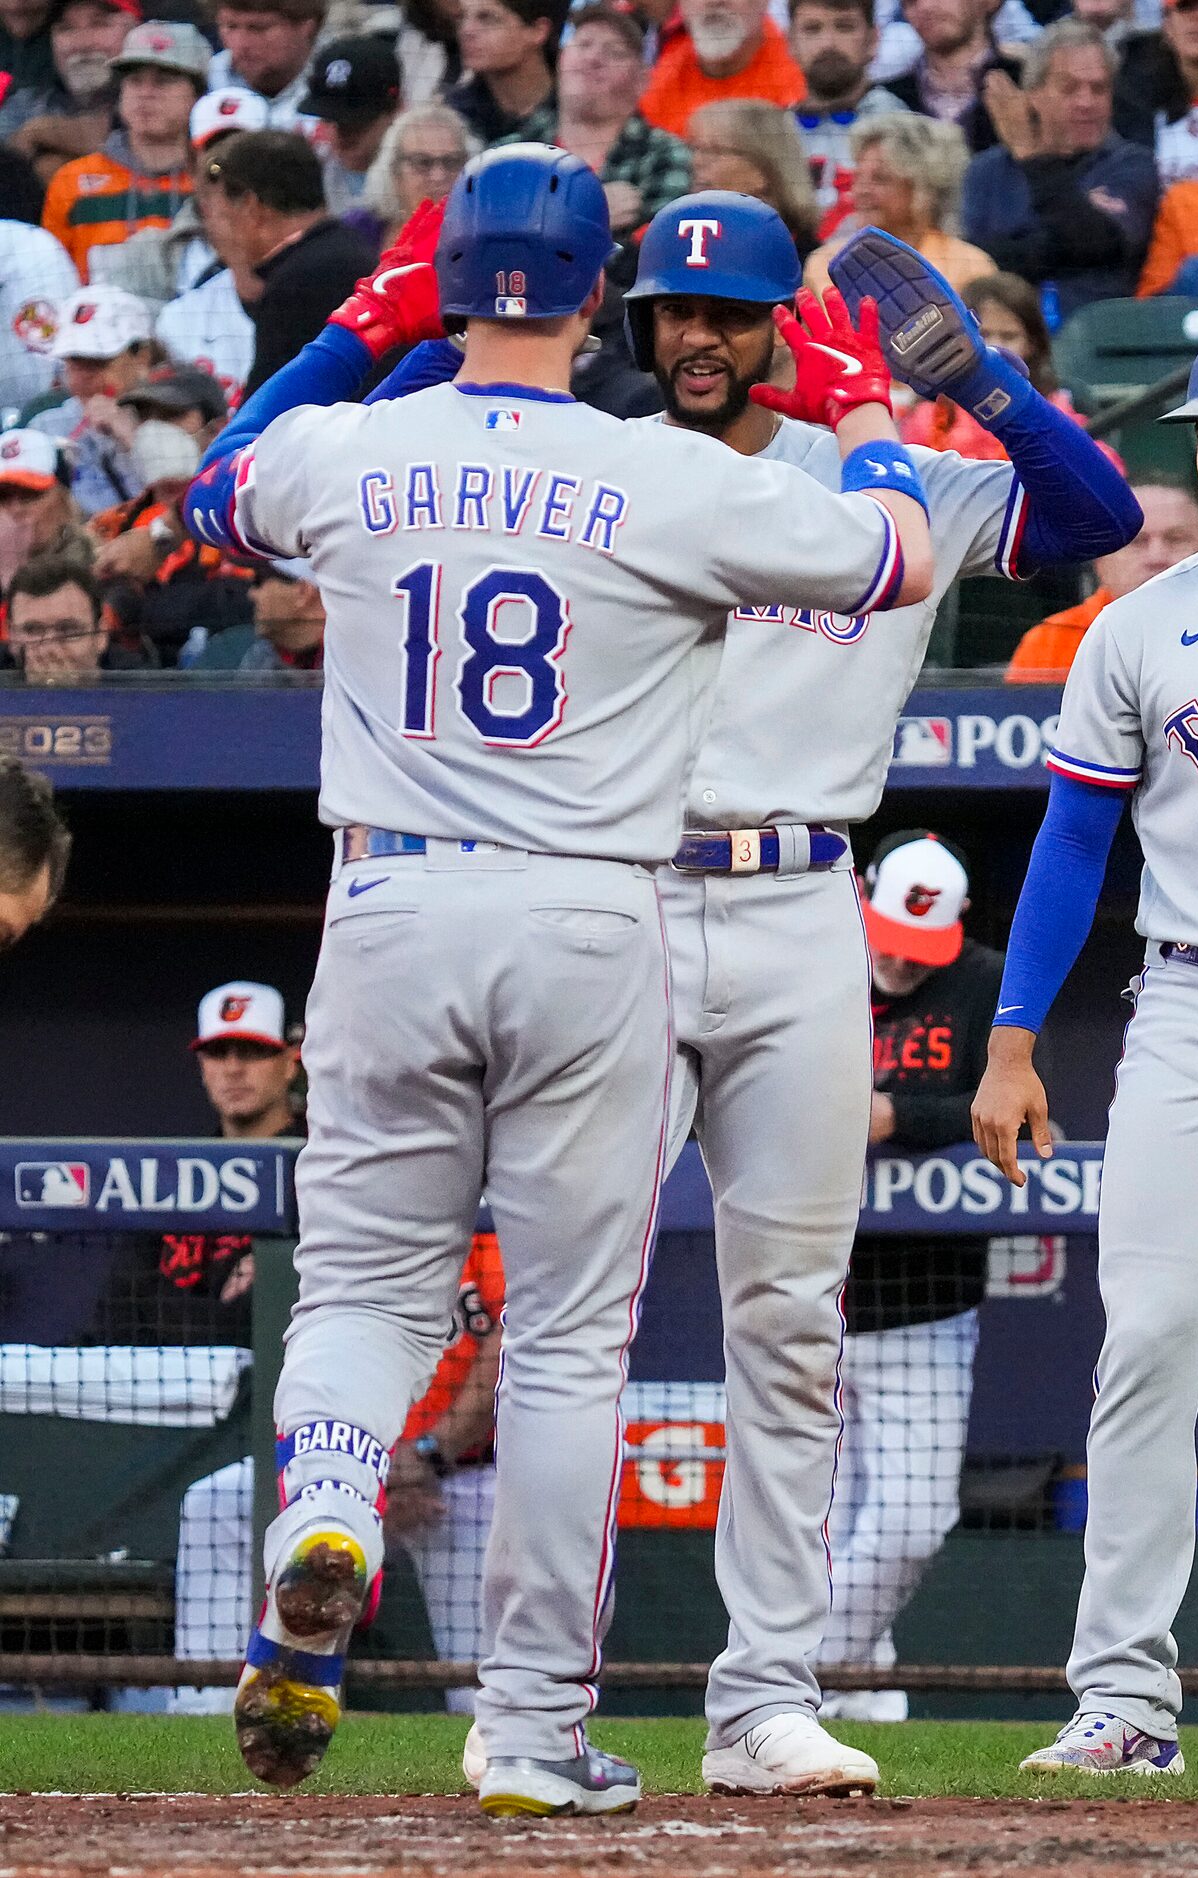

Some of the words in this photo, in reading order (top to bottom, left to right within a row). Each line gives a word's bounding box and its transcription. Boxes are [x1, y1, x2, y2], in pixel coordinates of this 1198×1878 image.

[678, 219, 722, 268] T
[496, 271, 526, 295] 18
[357, 461, 630, 557] GARVER
[390, 558, 574, 749] 18
[739, 839, 752, 862] 3
[873, 1026, 953, 1070] LES
[95, 1156, 260, 1212] ALDS
[635, 1424, 707, 1509] G
